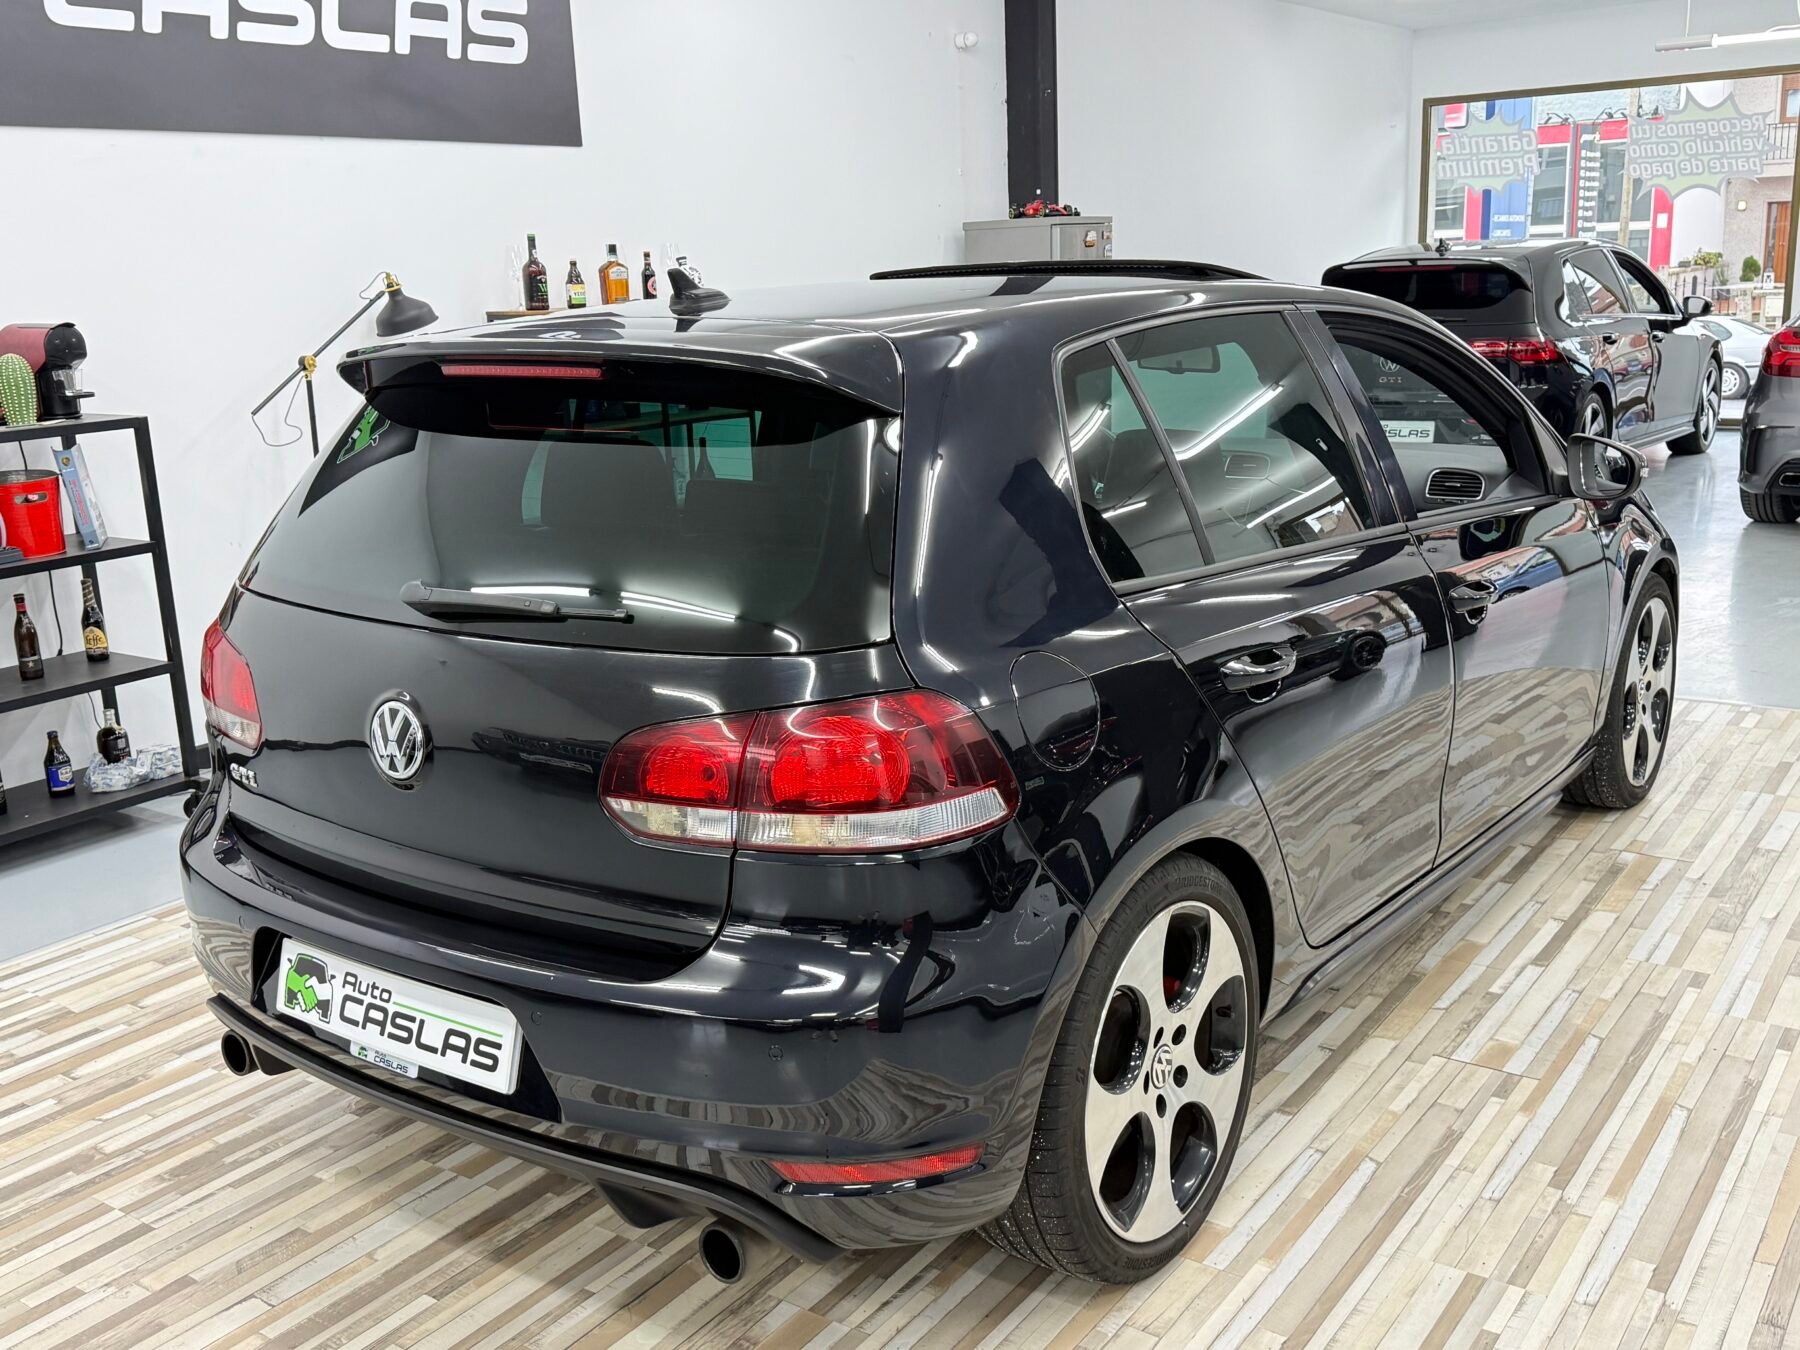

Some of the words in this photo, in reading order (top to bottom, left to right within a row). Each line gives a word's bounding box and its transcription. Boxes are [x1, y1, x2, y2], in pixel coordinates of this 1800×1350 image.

[1384, 428, 1432, 438] SLAS
[342, 971, 392, 1004] Auto
[339, 994, 503, 1073] CASLAS
[373, 1055, 409, 1074] CASLAS
